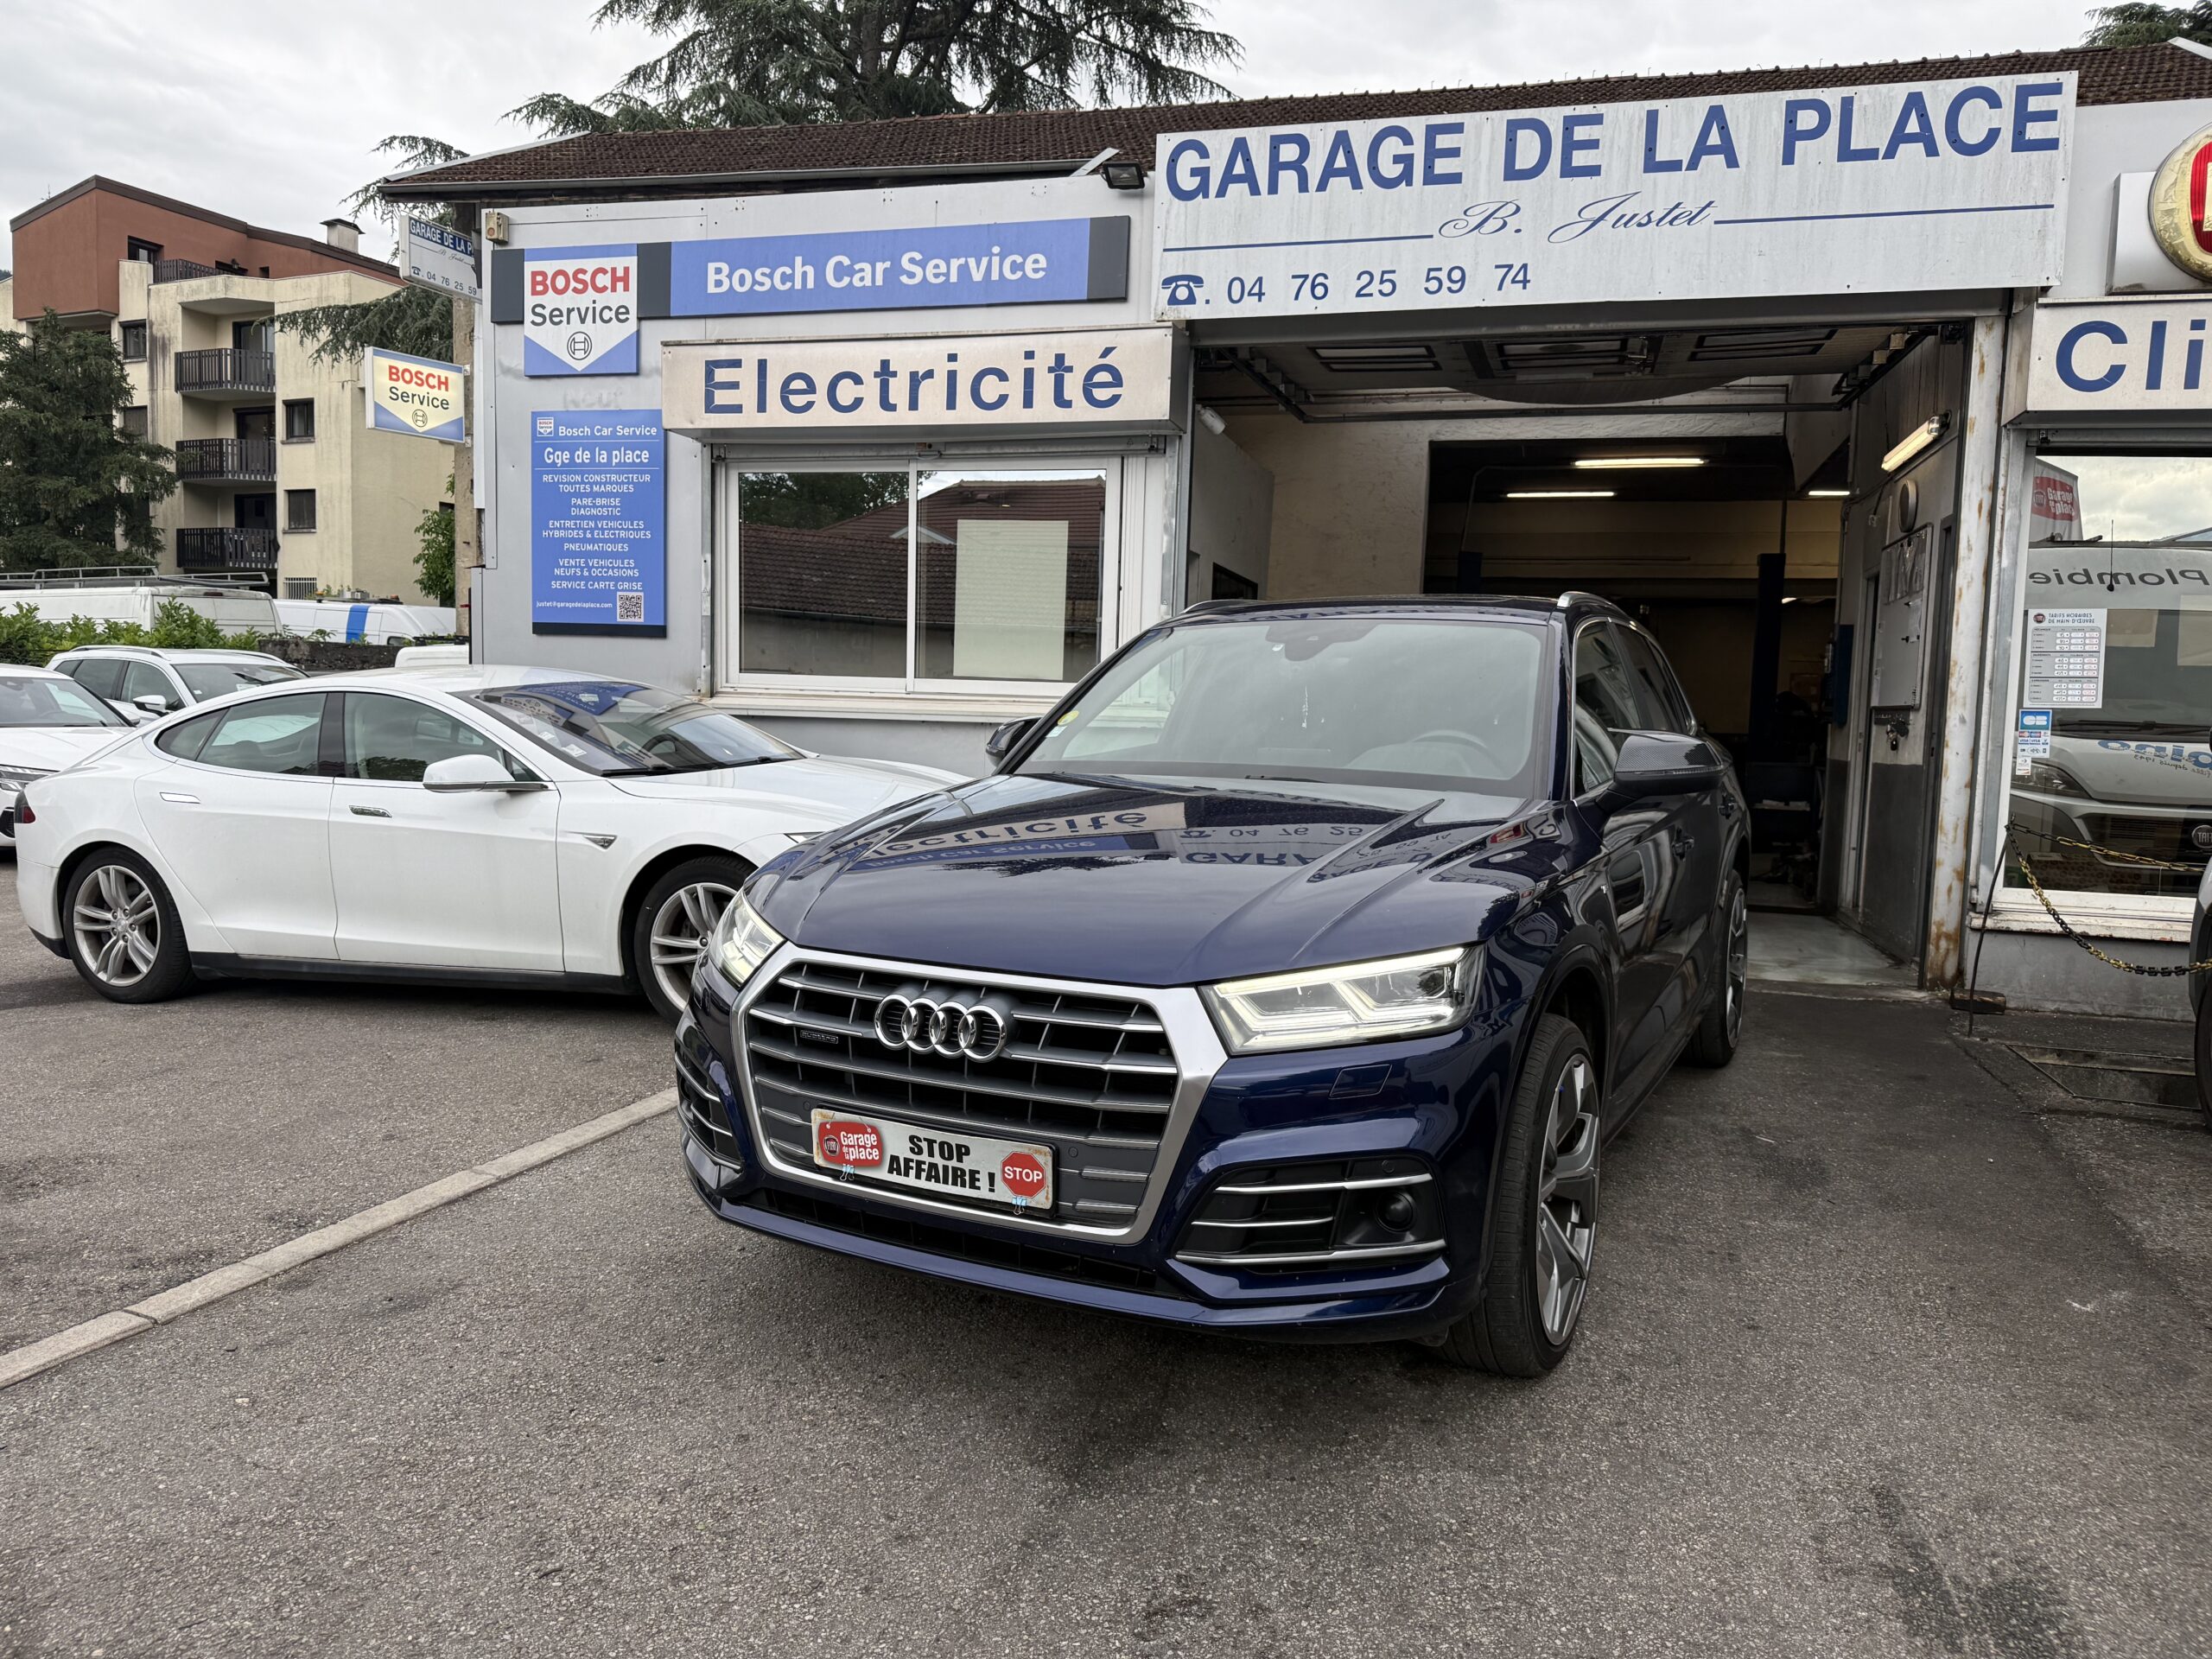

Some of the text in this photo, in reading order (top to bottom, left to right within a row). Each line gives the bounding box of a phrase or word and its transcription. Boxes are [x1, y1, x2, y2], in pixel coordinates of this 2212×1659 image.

[1166, 81, 2063, 201] GARAGE DE LA PLACE
[1438, 191, 1718, 244] B. Justet
[410, 220, 474, 257] GARAGE DE LA P
[531, 266, 630, 296] BOSCH
[706, 245, 1047, 294] Bosch Car Service
[427, 271, 477, 296] 04 76 25 59
[1227, 263, 1531, 304] 04 76 25 59 74
[530, 300, 631, 327] Service
[2056, 319, 2206, 392] Cli
[388, 365, 449, 392] BOSCH
[703, 346, 1124, 415] Electricité
[389, 386, 450, 410] Service
[558, 425, 657, 436] Bosch Car Service
[544, 447, 649, 467] Gge de la place
[543, 474, 651, 483] REVISION CONSTRUCTEUR
[558, 484, 634, 493] TOUTES MARQUES
[571, 498, 621, 506] PARE-BRISE
[543, 530, 584, 538] HYBRIDES
[594, 531, 652, 539] ELECTRIQUES
[549, 520, 595, 529] ENTRETIEN
[554, 568, 582, 576] NEUFS
[591, 569, 639, 577] OCCASIONS
[558, 558, 635, 568] VENTE VEHICULES
[551, 581, 586, 589] SERVICE
[617, 582, 643, 590] GRISE
[840, 1131, 878, 1147] Garage
[908, 1135, 970, 1164] STOP
[849, 1146, 880, 1161] place
[887, 1154, 995, 1192] AFFAIRE !
[1004, 1166, 1043, 1182] STOP
